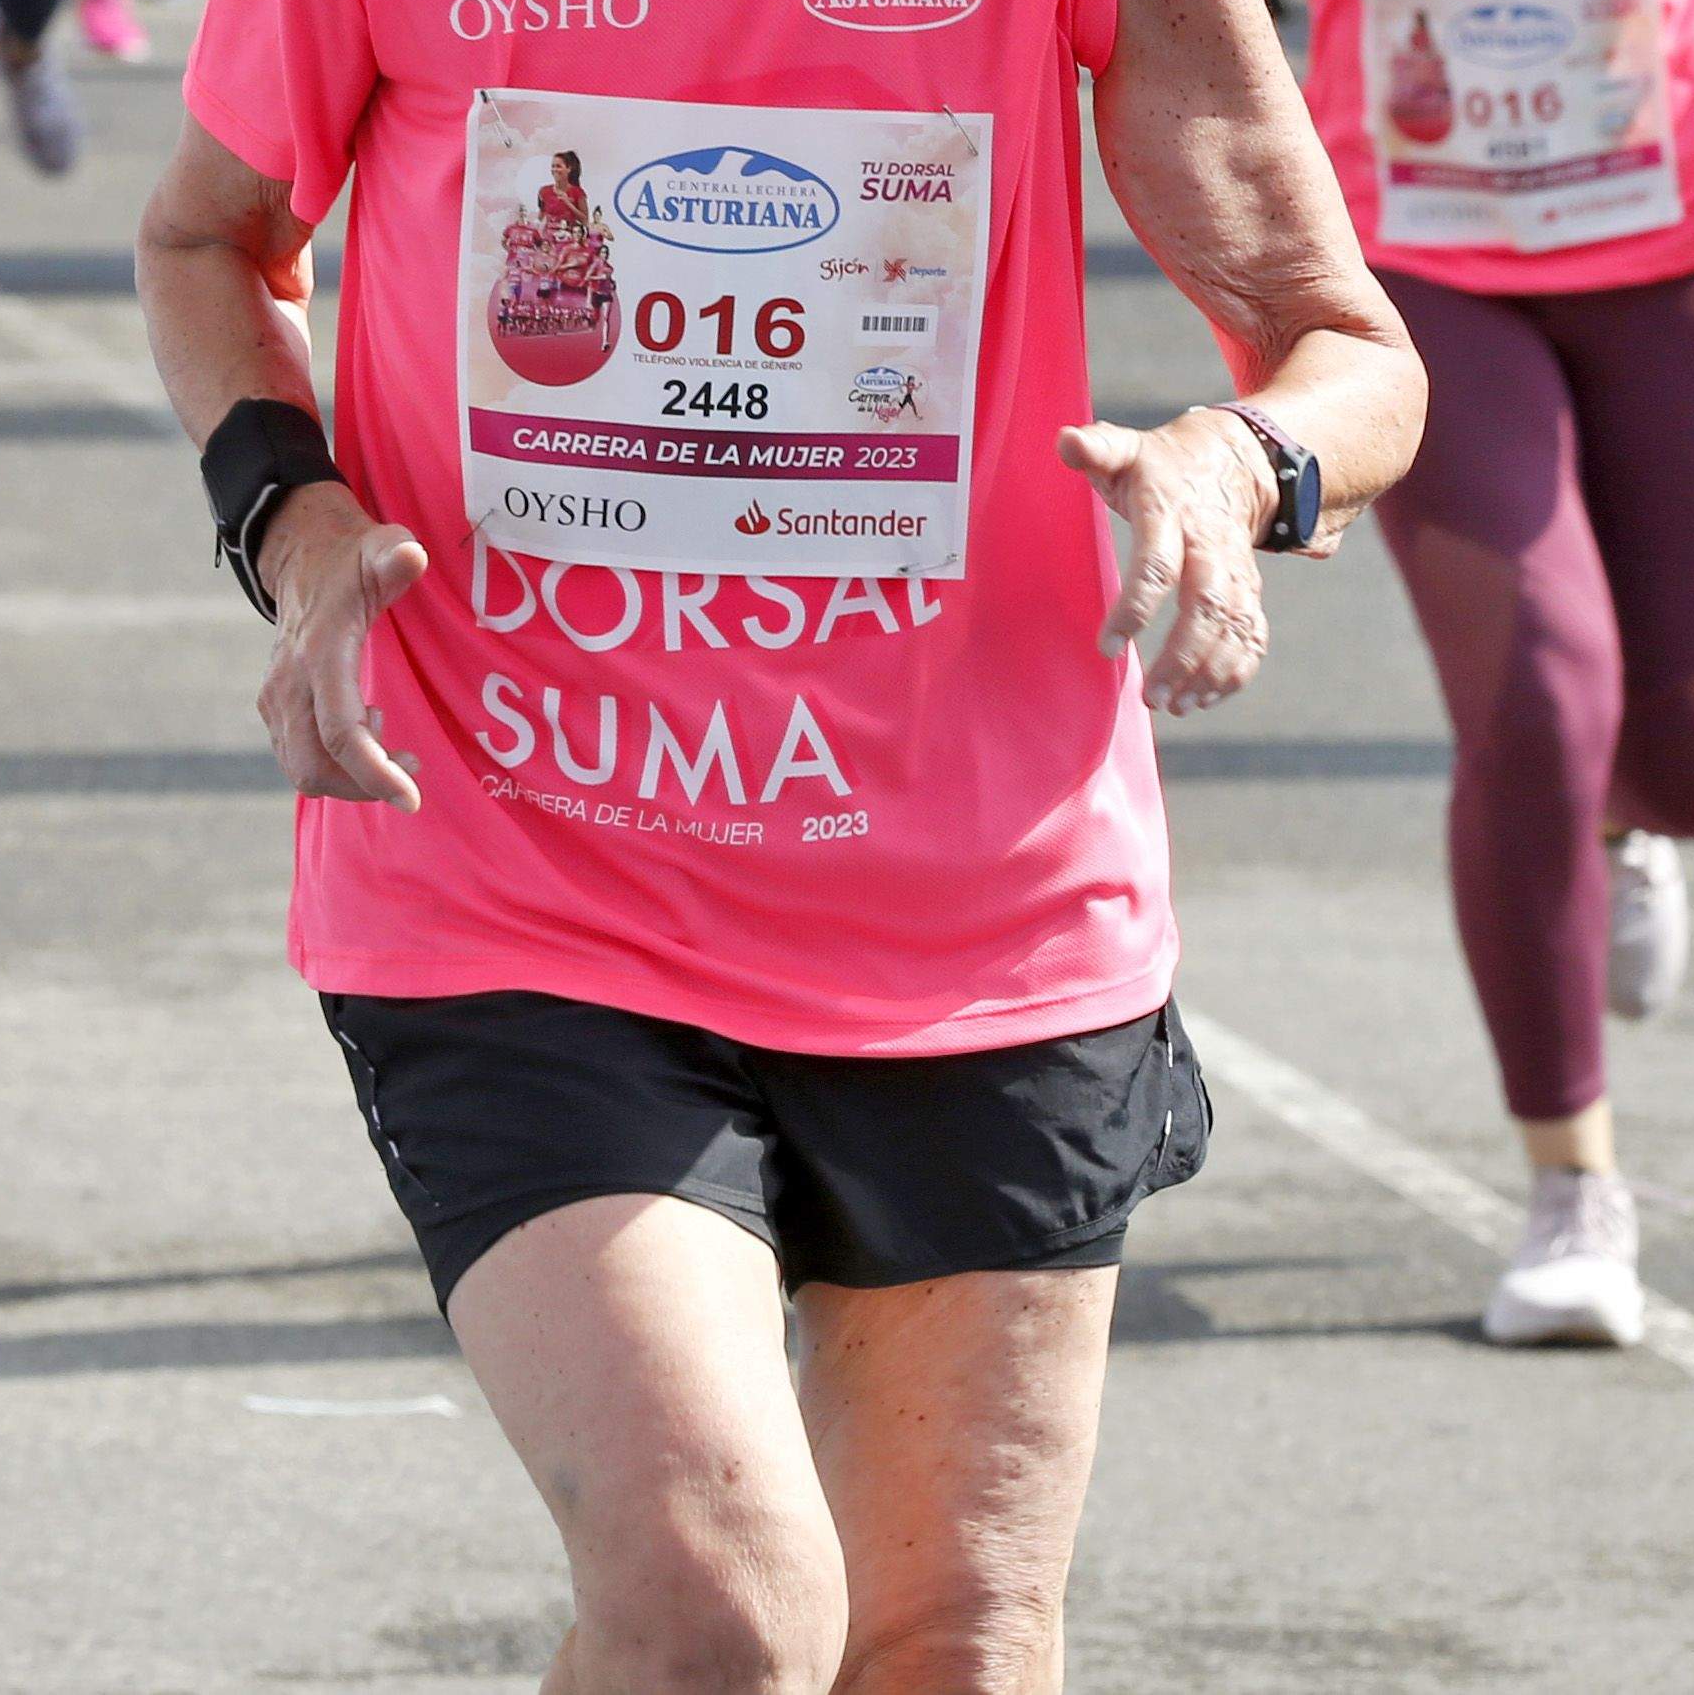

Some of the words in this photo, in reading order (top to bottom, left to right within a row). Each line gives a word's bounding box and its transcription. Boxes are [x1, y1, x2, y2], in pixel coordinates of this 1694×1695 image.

[666, 180, 740, 195] CENTRAL
[746, 184, 818, 198] LECHERA
[860, 161, 883, 175] TU
[887, 162, 956, 177] DORSAL
[859, 177, 953, 203] SUMA
[909, 266, 947, 278] Deporte
[634, 291, 807, 359] 016
[689, 357, 743, 369] VIOLENCIA
[745, 360, 758, 370] DE
[661, 379, 769, 421] 2448
[512, 428, 648, 460] CARRERA
[656, 440, 699, 464] DE
[703, 443, 741, 465] LA
[748, 444, 845, 468] MUJER
[854, 447, 919, 469] 2023
[504, 486, 647, 532] OYSHO
[777, 508, 928, 537] Santander
[470, 535, 942, 653] DORSAL
[474, 672, 852, 807] SUMA
[594, 803, 632, 828] DE
[636, 809, 668, 833] LA
[675, 817, 764, 846] MUJER
[801, 810, 869, 843] 2023
